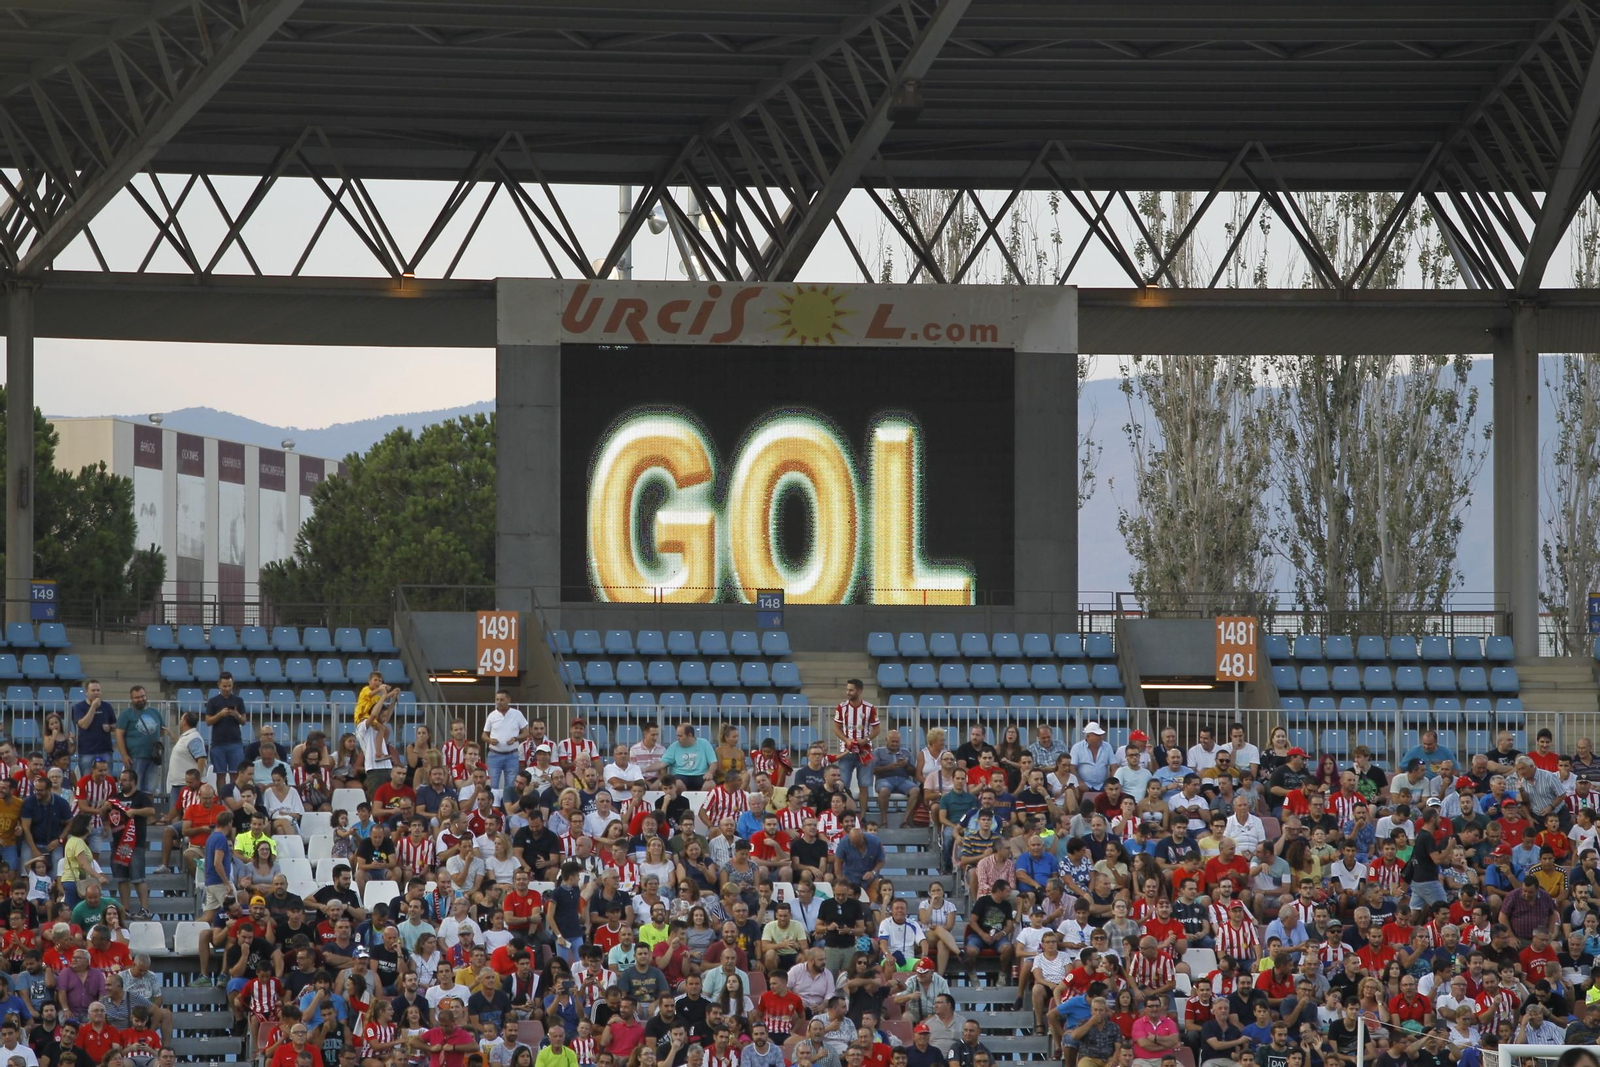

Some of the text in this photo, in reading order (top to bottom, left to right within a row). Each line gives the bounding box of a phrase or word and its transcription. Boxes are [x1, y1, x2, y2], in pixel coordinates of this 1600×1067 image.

[587, 407, 977, 607] GOL
[32, 589, 54, 600] 149
[759, 598, 781, 609] 148
[1593, 602, 1600, 612] 1
[479, 615, 509, 641] 149
[1217, 621, 1247, 646] 148
[479, 648, 506, 673] 49
[1219, 653, 1245, 677] 48
